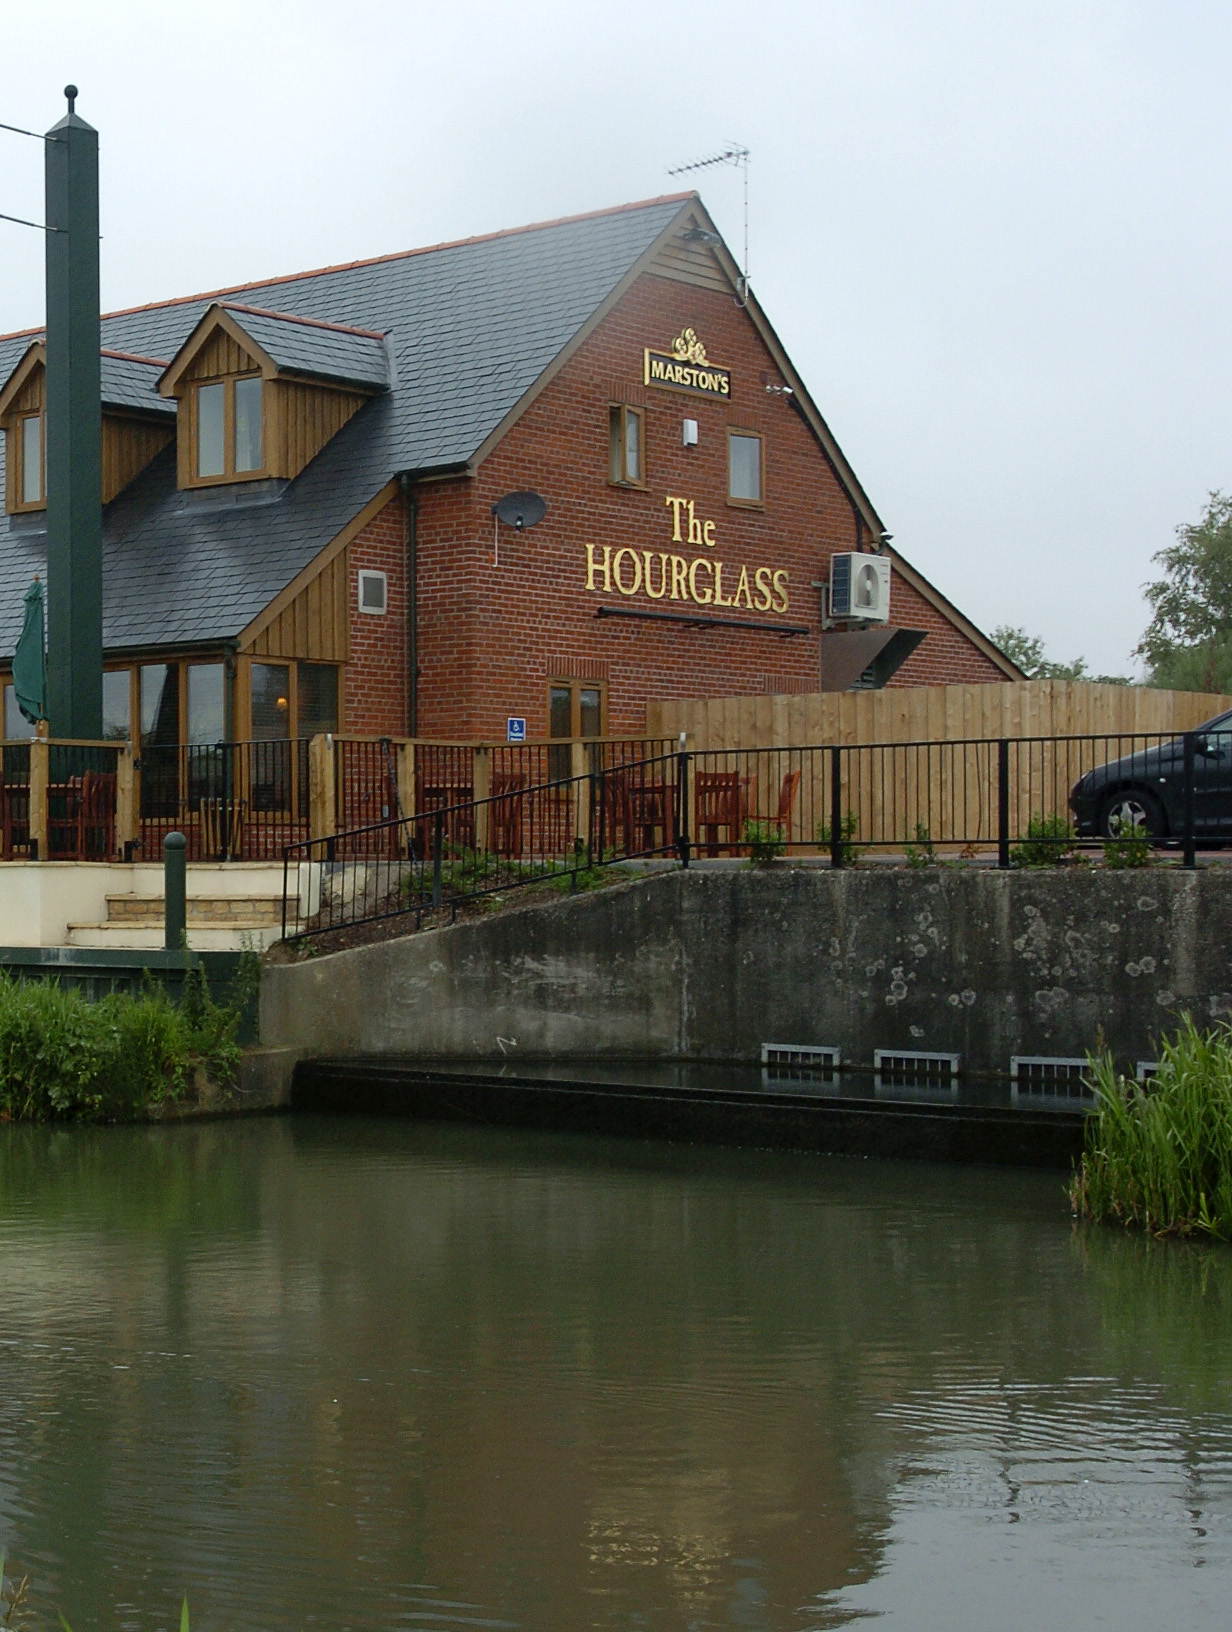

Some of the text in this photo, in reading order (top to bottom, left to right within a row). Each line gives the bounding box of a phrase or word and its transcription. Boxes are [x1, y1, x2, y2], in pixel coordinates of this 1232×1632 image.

[651, 360, 729, 394] MARSTON'S
[665, 496, 716, 547] The
[584, 543, 790, 613] HOURGLASS
